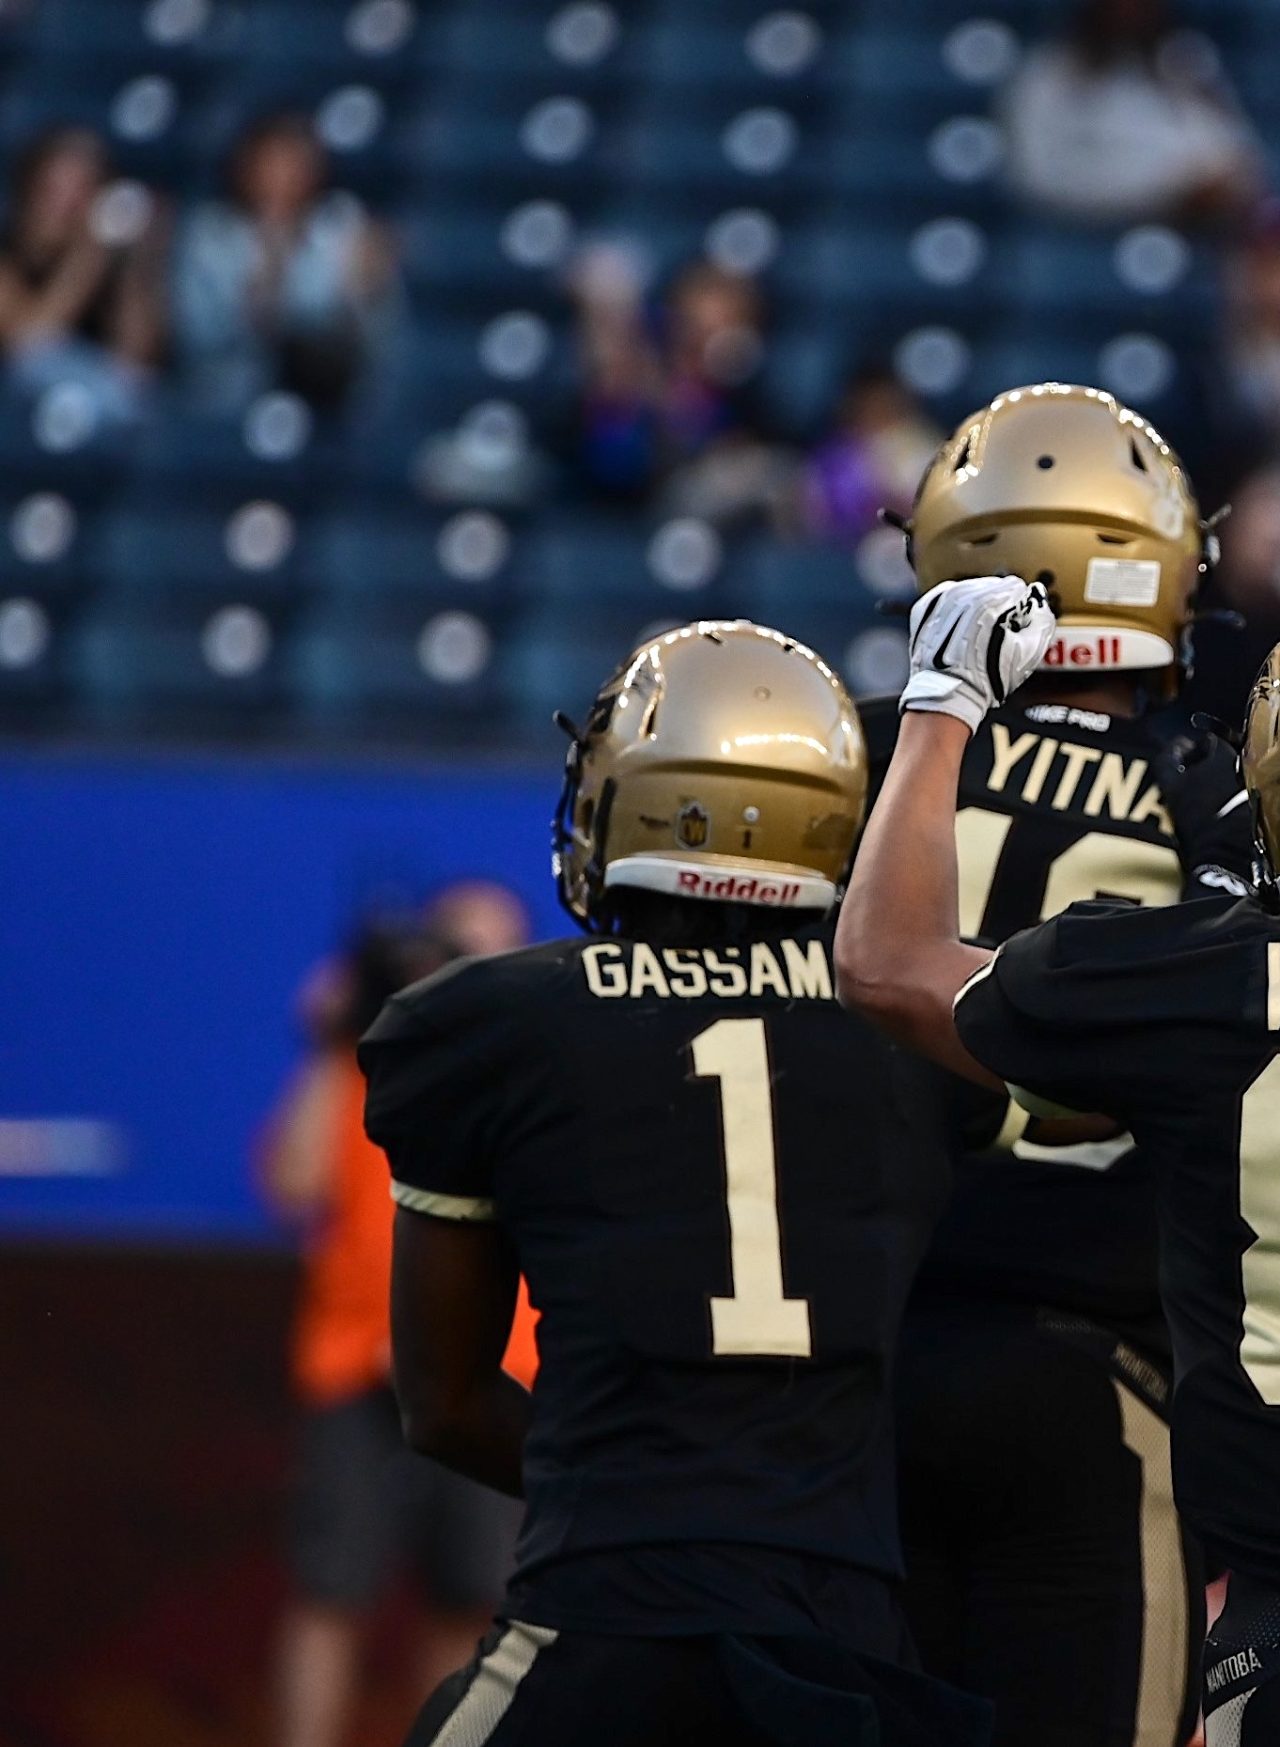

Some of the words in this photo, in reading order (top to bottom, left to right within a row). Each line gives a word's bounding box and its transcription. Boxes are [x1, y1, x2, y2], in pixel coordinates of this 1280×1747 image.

[679, 871, 800, 903] Riddell
[581, 938, 833, 999] GASSAM
[691, 1017, 811, 1357] 1
